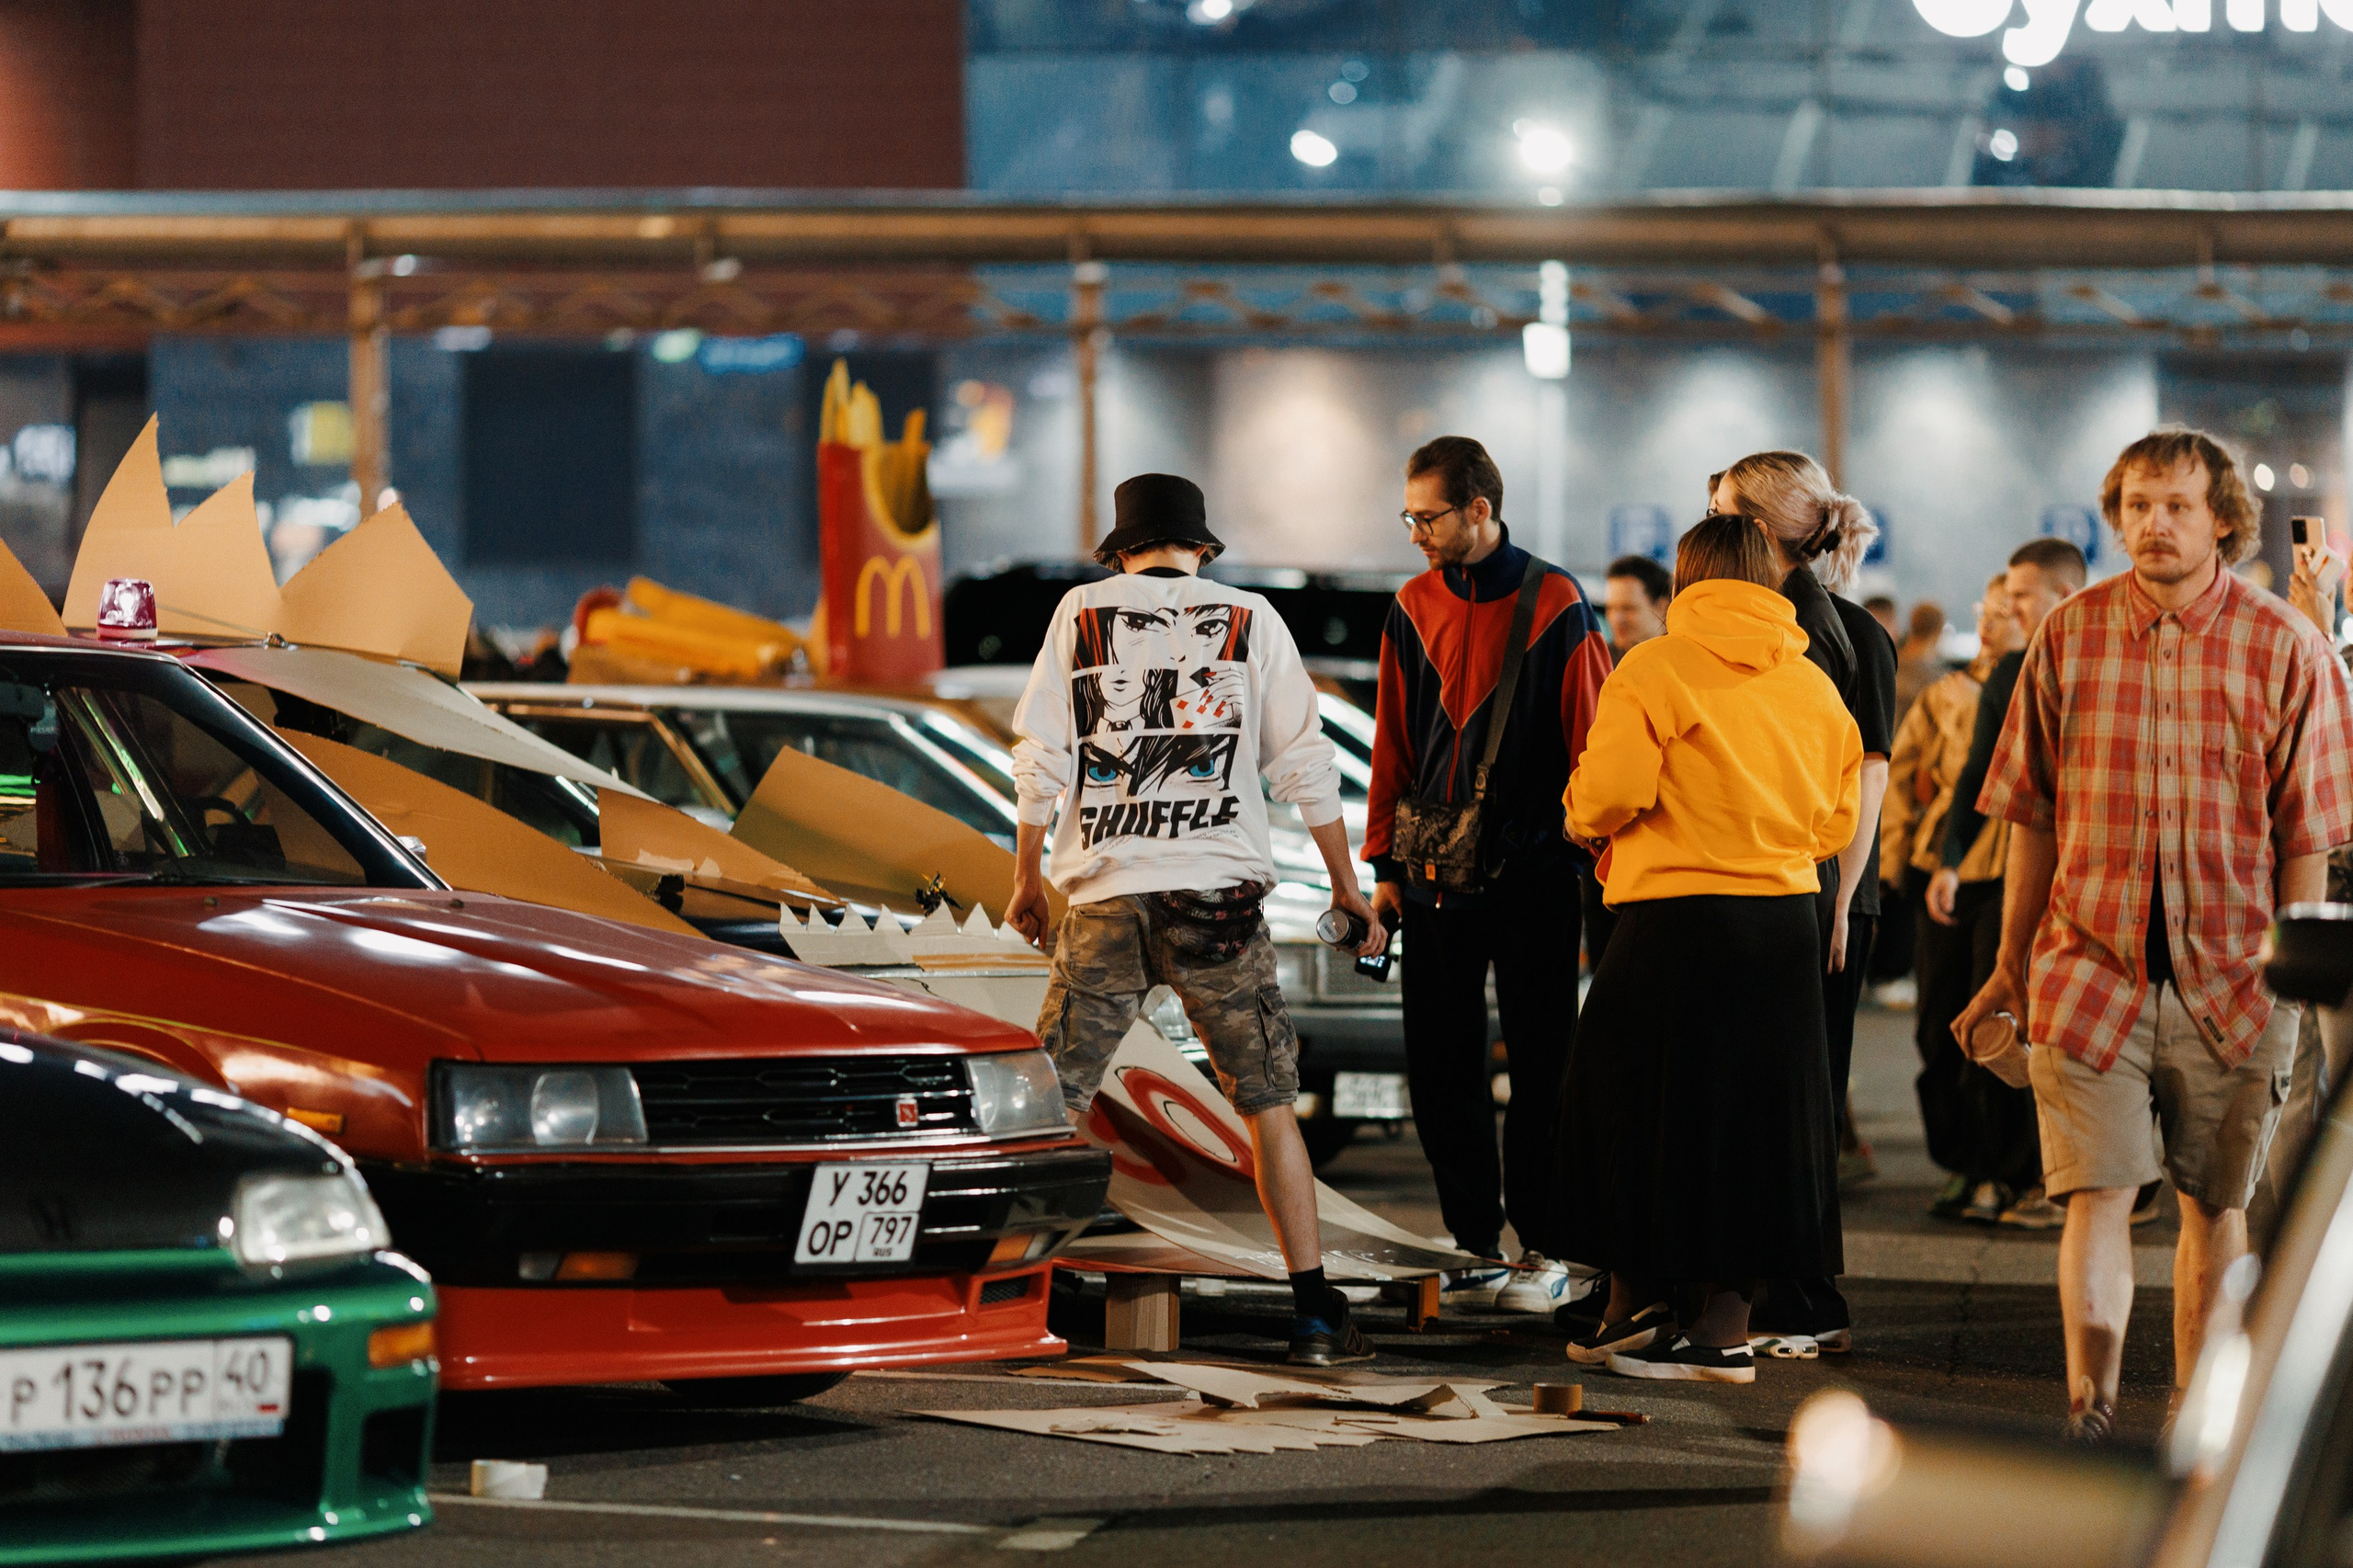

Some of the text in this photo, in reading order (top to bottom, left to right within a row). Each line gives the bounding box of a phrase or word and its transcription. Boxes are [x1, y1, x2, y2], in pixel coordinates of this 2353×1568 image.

[1080, 796, 1240, 850] SHUFFLE
[858, 1171, 908, 1205] 366
[808, 1216, 913, 1256] ОР 797
[223, 1349, 269, 1394] 40
